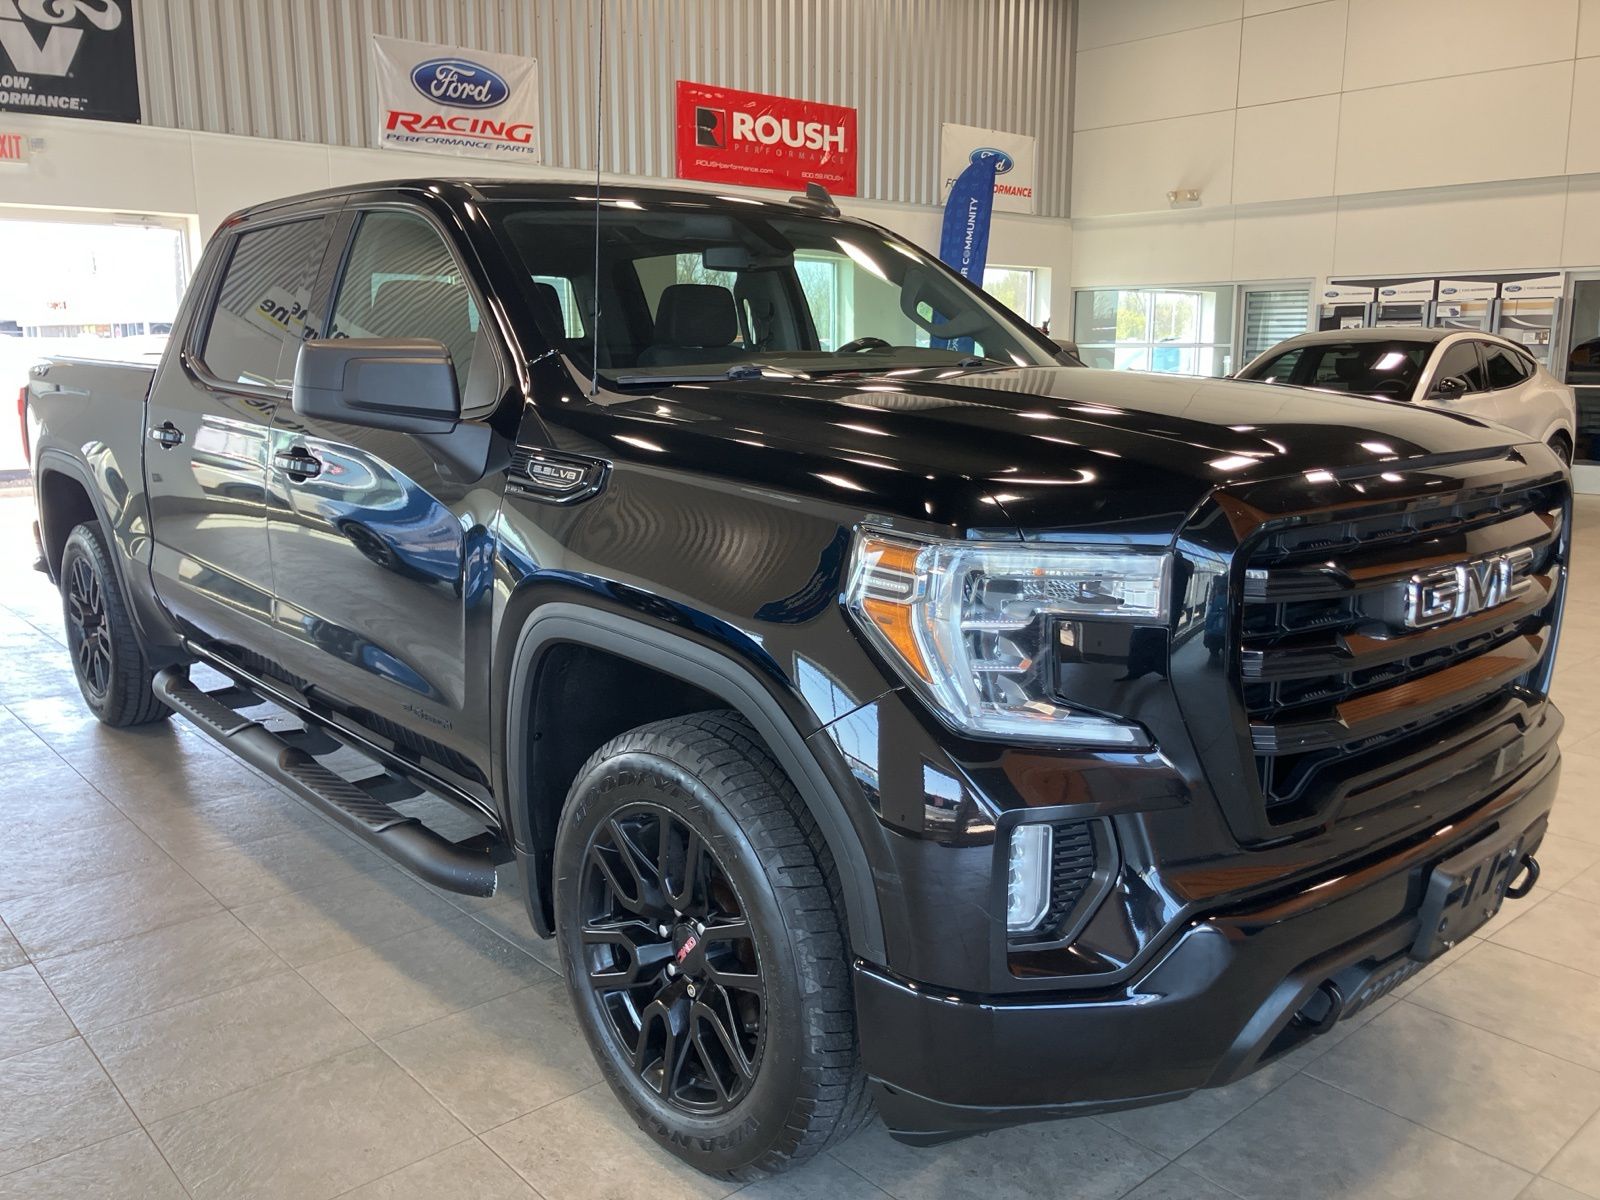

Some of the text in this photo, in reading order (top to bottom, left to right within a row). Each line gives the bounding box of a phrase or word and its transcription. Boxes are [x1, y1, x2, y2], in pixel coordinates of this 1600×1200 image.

[0, 75, 32, 90] OW.
[430, 65, 491, 103] Ford
[386, 110, 534, 143] RACING
[386, 133, 534, 153] PERFORMANCE PARTS
[733, 112, 844, 152] ROUSH
[734, 143, 844, 164] PERFORMANCE
[963, 197, 978, 265] COMMUNITY
[1404, 547, 1534, 628] GMC
